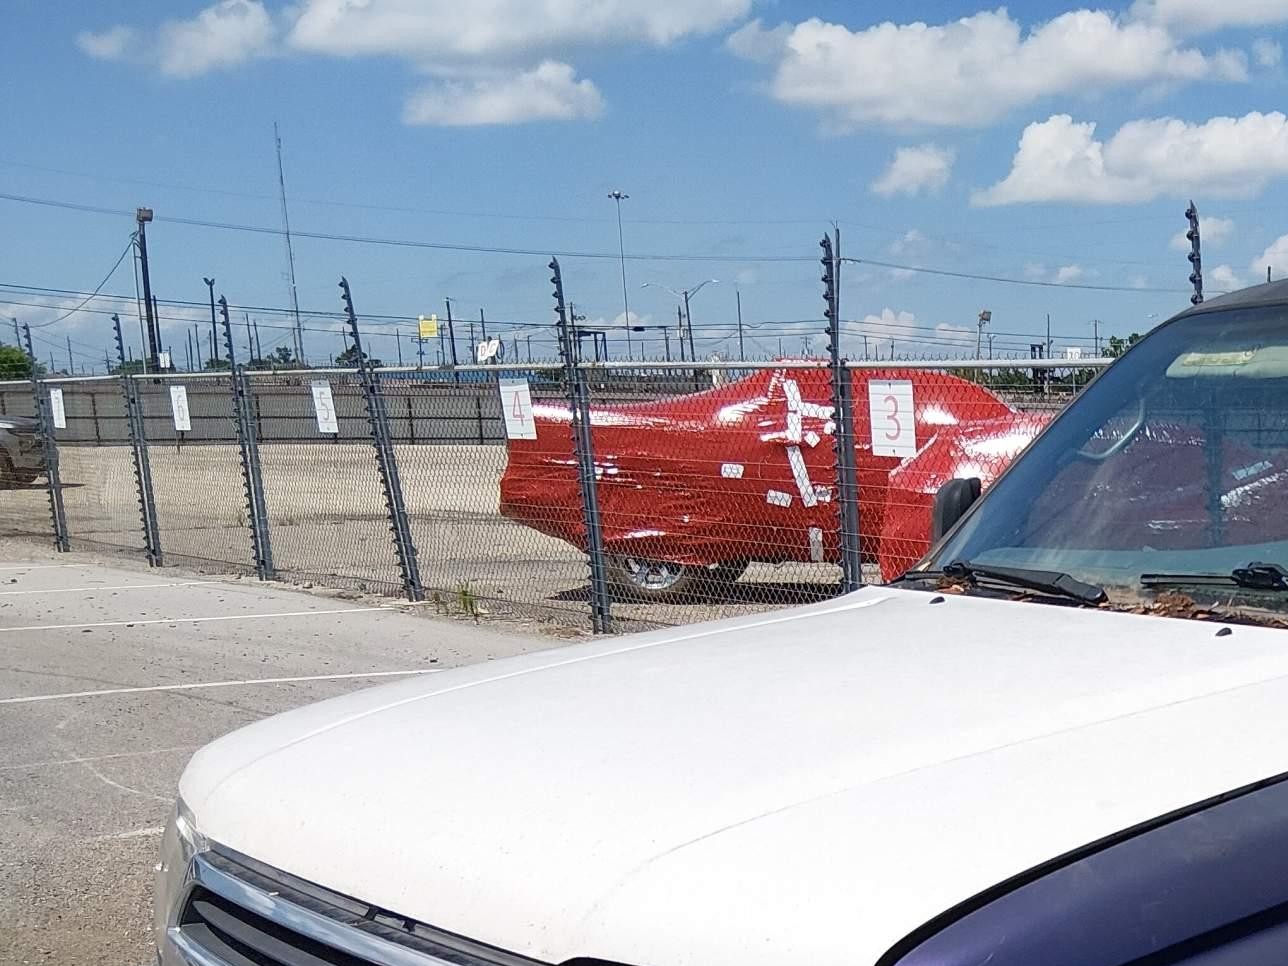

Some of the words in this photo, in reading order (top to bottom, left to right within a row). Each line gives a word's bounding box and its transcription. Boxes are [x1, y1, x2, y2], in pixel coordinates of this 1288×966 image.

[176, 394, 185, 421] 6
[319, 391, 330, 421] 5
[512, 391, 525, 427] 4
[884, 395, 902, 441] 3
